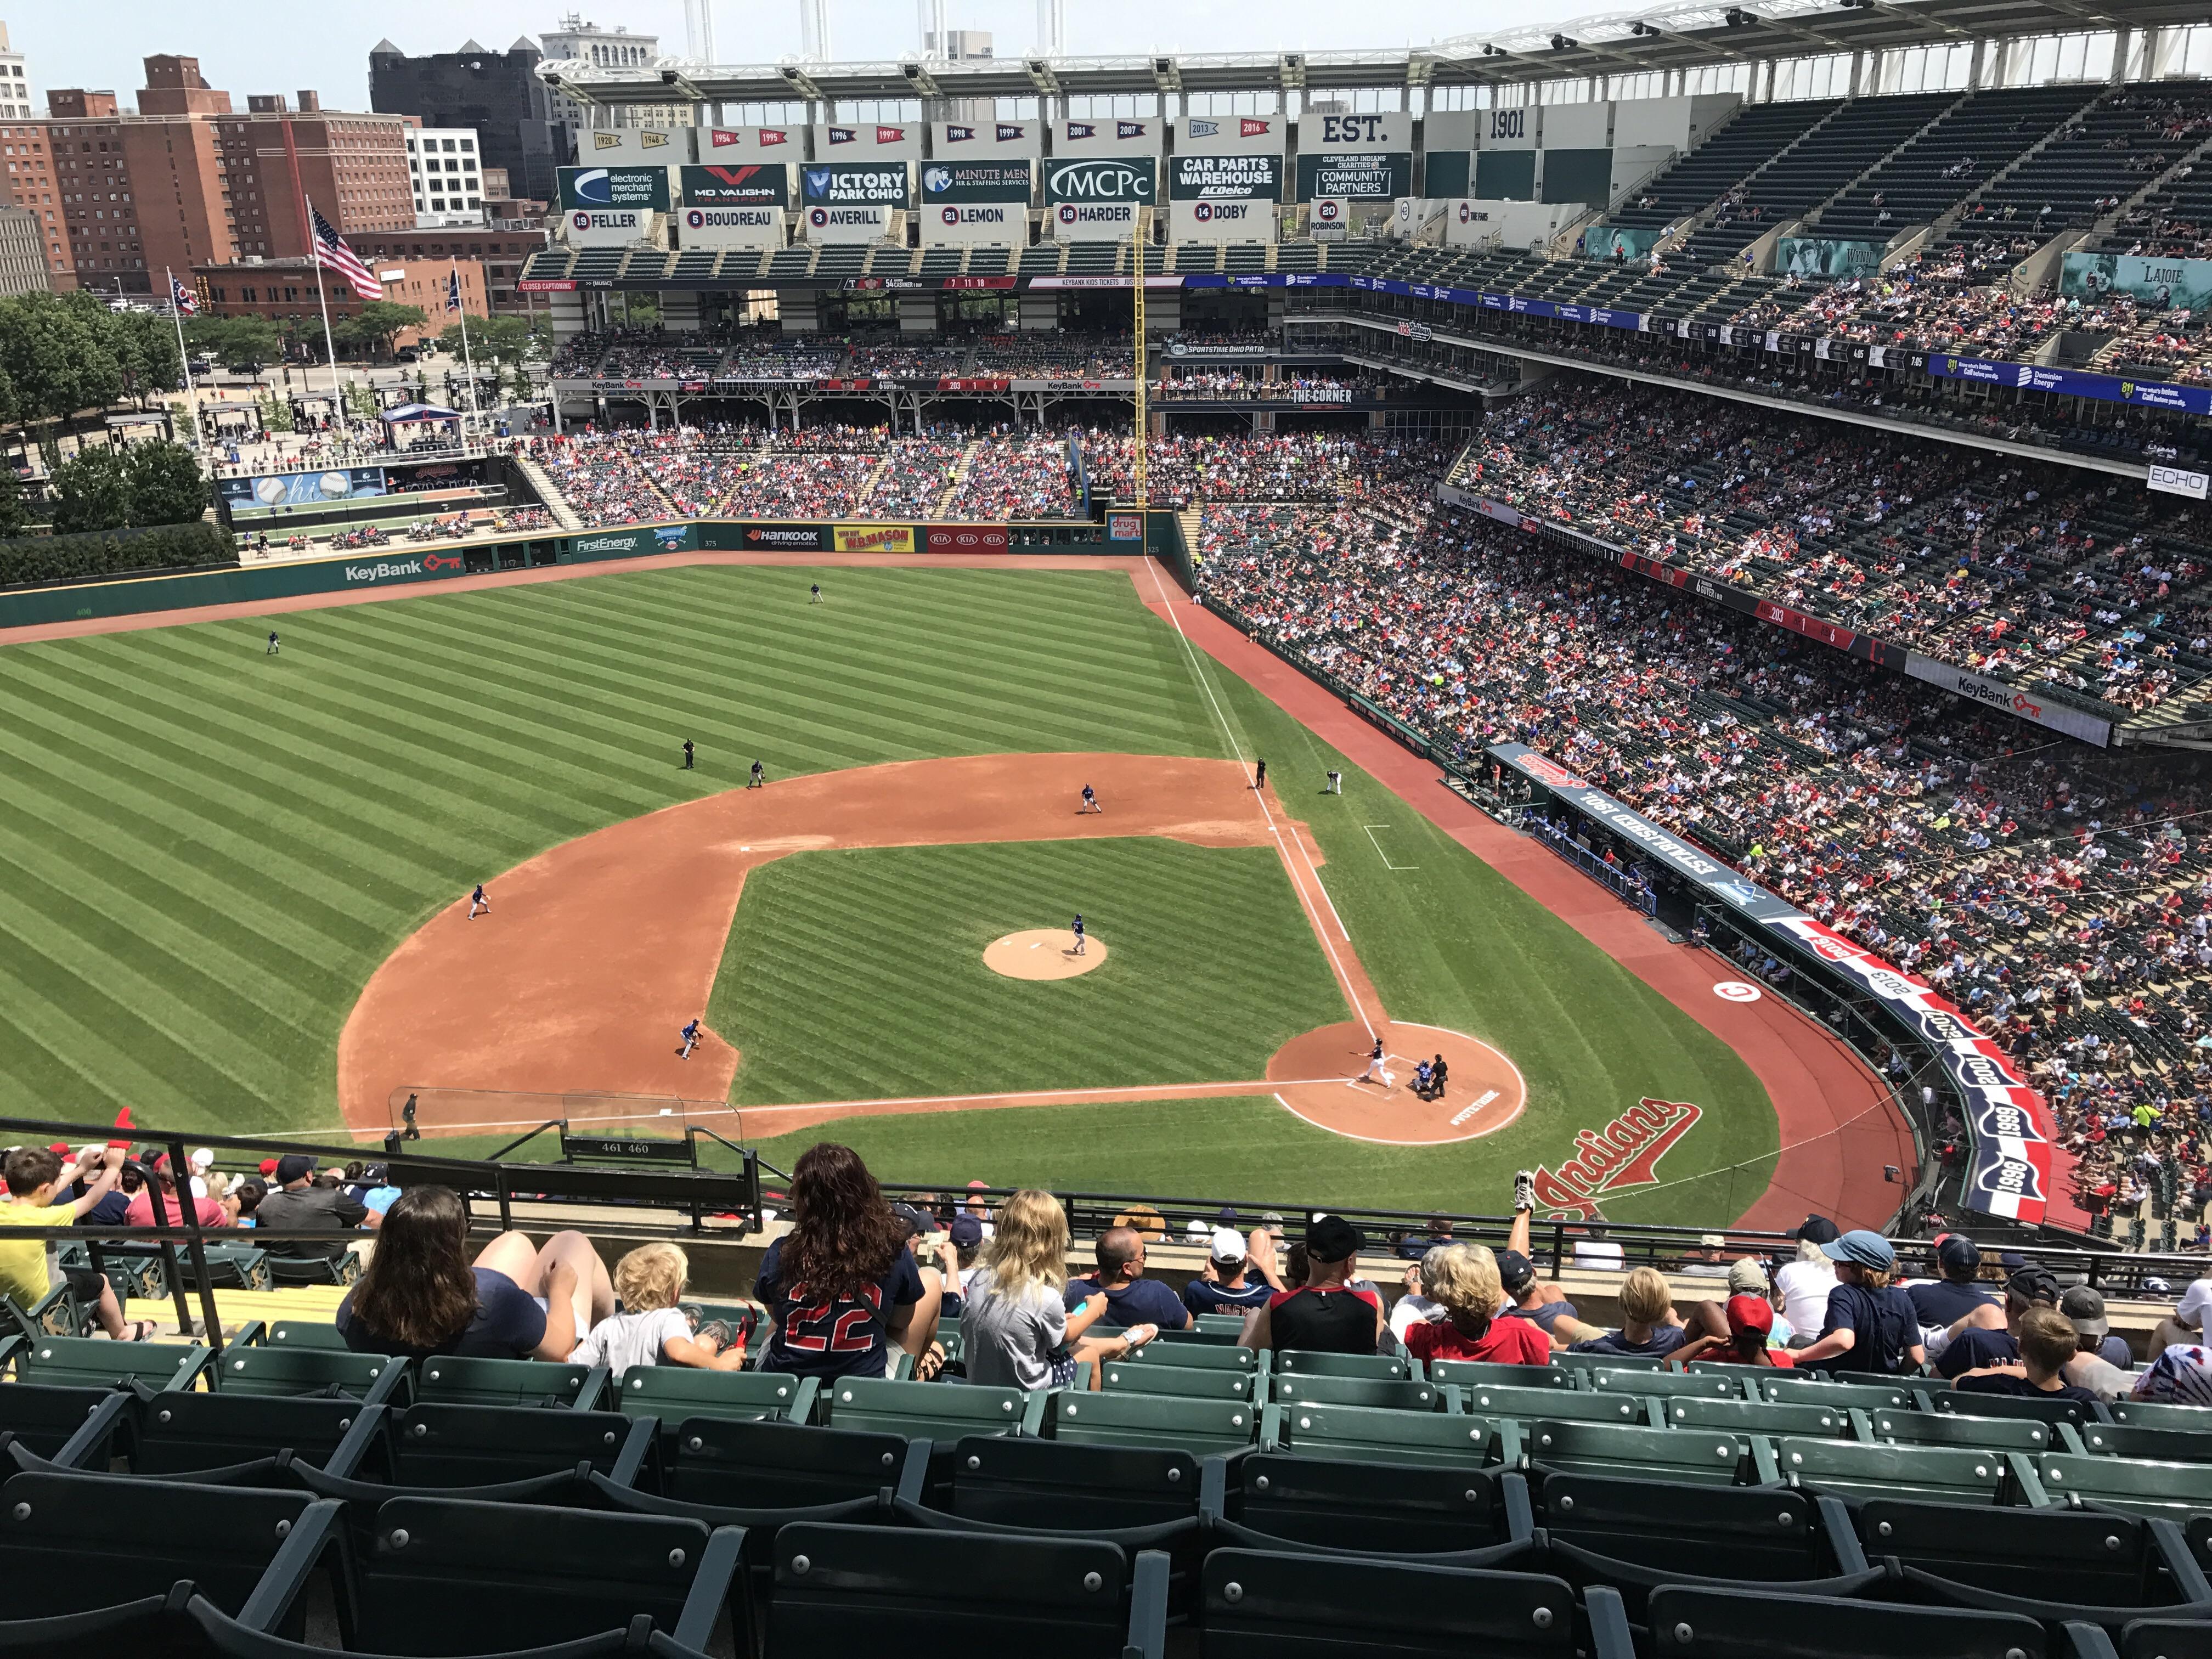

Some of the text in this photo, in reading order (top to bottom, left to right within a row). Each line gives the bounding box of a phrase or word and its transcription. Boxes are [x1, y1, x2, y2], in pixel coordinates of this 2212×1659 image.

[1192, 123, 1209, 133] 2013
[1244, 123, 1260, 133] 2016
[1323, 115, 1388, 142] EST.
[1491, 110, 1524, 138] 1901
[832, 131, 847, 141] 1996
[879, 130, 894, 140] 1997
[950, 128, 966, 138] 1998
[999, 128, 1014, 138] 1999
[1070, 127, 1086, 136] 2001
[1120, 126, 1136, 135] 2007
[597, 136, 613, 145] 1920
[644, 135, 660, 144] 1948
[714, 134, 731, 144] 1954
[762, 132, 778, 142] 1995
[1183, 157, 1268, 172] CAR PARTS
[610, 173, 652, 184] electronic
[955, 168, 1029, 180] MINUTE MEN
[1178, 171, 1272, 184] WAREHOUSE
[1322, 171, 1386, 182] COMMUNITY
[611, 183, 652, 192] merchant
[719, 188, 775, 196] VAUGHN
[1325, 183, 1381, 194] PARTNERS
[612, 192, 650, 202] systems
[829, 188, 903, 200] PARK OHIO
[945, 208, 1003, 223] 21 LEMON
[1063, 207, 1131, 222] 18 HARDER
[1198, 205, 1248, 219] 14 DOBY
[1322, 206, 1335, 216] 20
[1401, 205, 1408, 216] 42
[576, 214, 636, 228] 19 FELLER
[692, 212, 771, 226] 5 BOUDREAU
[816, 210, 881, 225] 3 AVERILL
[1311, 222, 1345, 230] ROBINSON
[1847, 247, 1872, 263] WYNN
[2144, 265, 2183, 284] LAJOIE
[885, 279, 894, 287] 54
[964, 279, 971, 287] 11
[2034, 371, 2063, 381] Dominion
[592, 381, 624, 391] KeyBank
[1048, 382, 1082, 391] KeyBank
[2033, 377, 2055, 388] Energy
[2121, 382, 2134, 394] 811
[1293, 390, 1352, 403] THE CORNER
[2142, 392, 2154, 401] Call
[2152, 468, 2203, 489] ECHO
[288, 475, 321, 503] hi
[1459, 494, 1481, 511] KeyBank
[1113, 517, 1136, 529] drug
[1115, 529, 1142, 537] mart
[577, 537, 636, 551] FirstEnergy
[346, 560, 422, 582] KeyBank
[1696, 579, 1701, 592] 6
[1830, 629, 1835, 642] 6
[1957, 676, 2012, 708] KeyBank
[1612, 815, 1718, 874] ESTABLISHED
[1813, 938, 1852, 959] 2016
[1871, 970, 1912, 995] 2013
[1926, 1011, 1963, 1039] 2007
[1966, 1057, 2000, 1085] 2001
[1996, 1107, 2022, 1137] 1999
[602, 1143, 648, 1153] 461 460
[1534, 1096, 1702, 1233] Indians
[1997, 1161, 2028, 1194] 1998
[785, 1281, 882, 1352] 22
